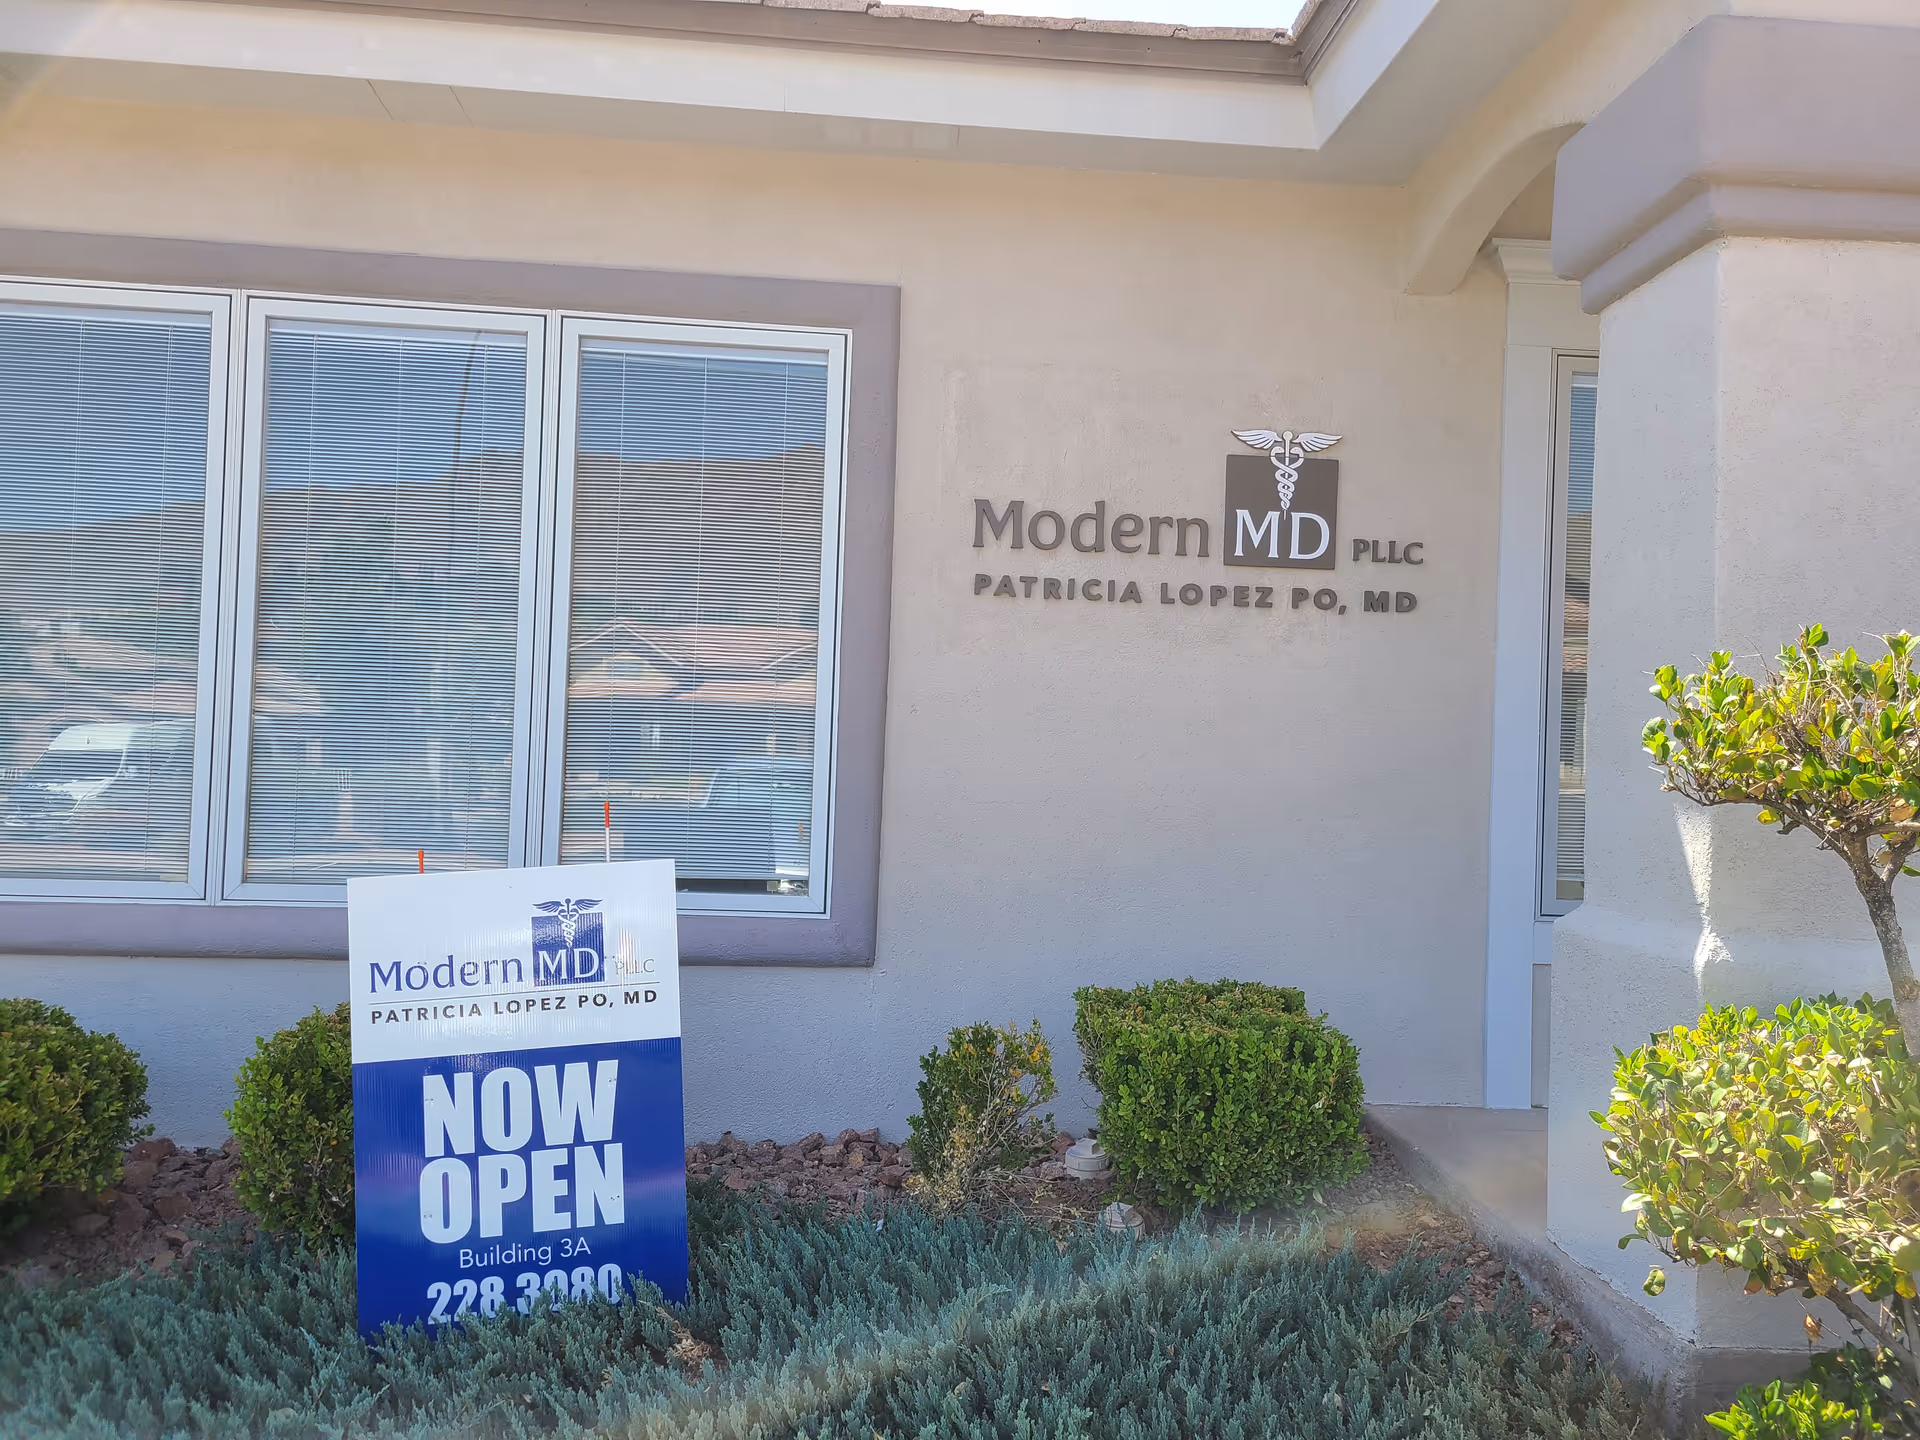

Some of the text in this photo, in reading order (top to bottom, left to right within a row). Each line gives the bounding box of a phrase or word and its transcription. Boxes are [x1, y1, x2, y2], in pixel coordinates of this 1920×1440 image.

[972, 498, 1424, 566] Modern MD PLLC
[973, 573, 1417, 615] PATRICIA LOPEZ PO, MD
[369, 954, 524, 994] Modern
[537, 946, 600, 981] MD
[371, 989, 658, 1025] PATRICIA LOPEZ PO, MD
[423, 1059, 619, 1158] NOW
[419, 1142, 625, 1244] OPEN
[459, 1236, 592, 1269] Building 3A
